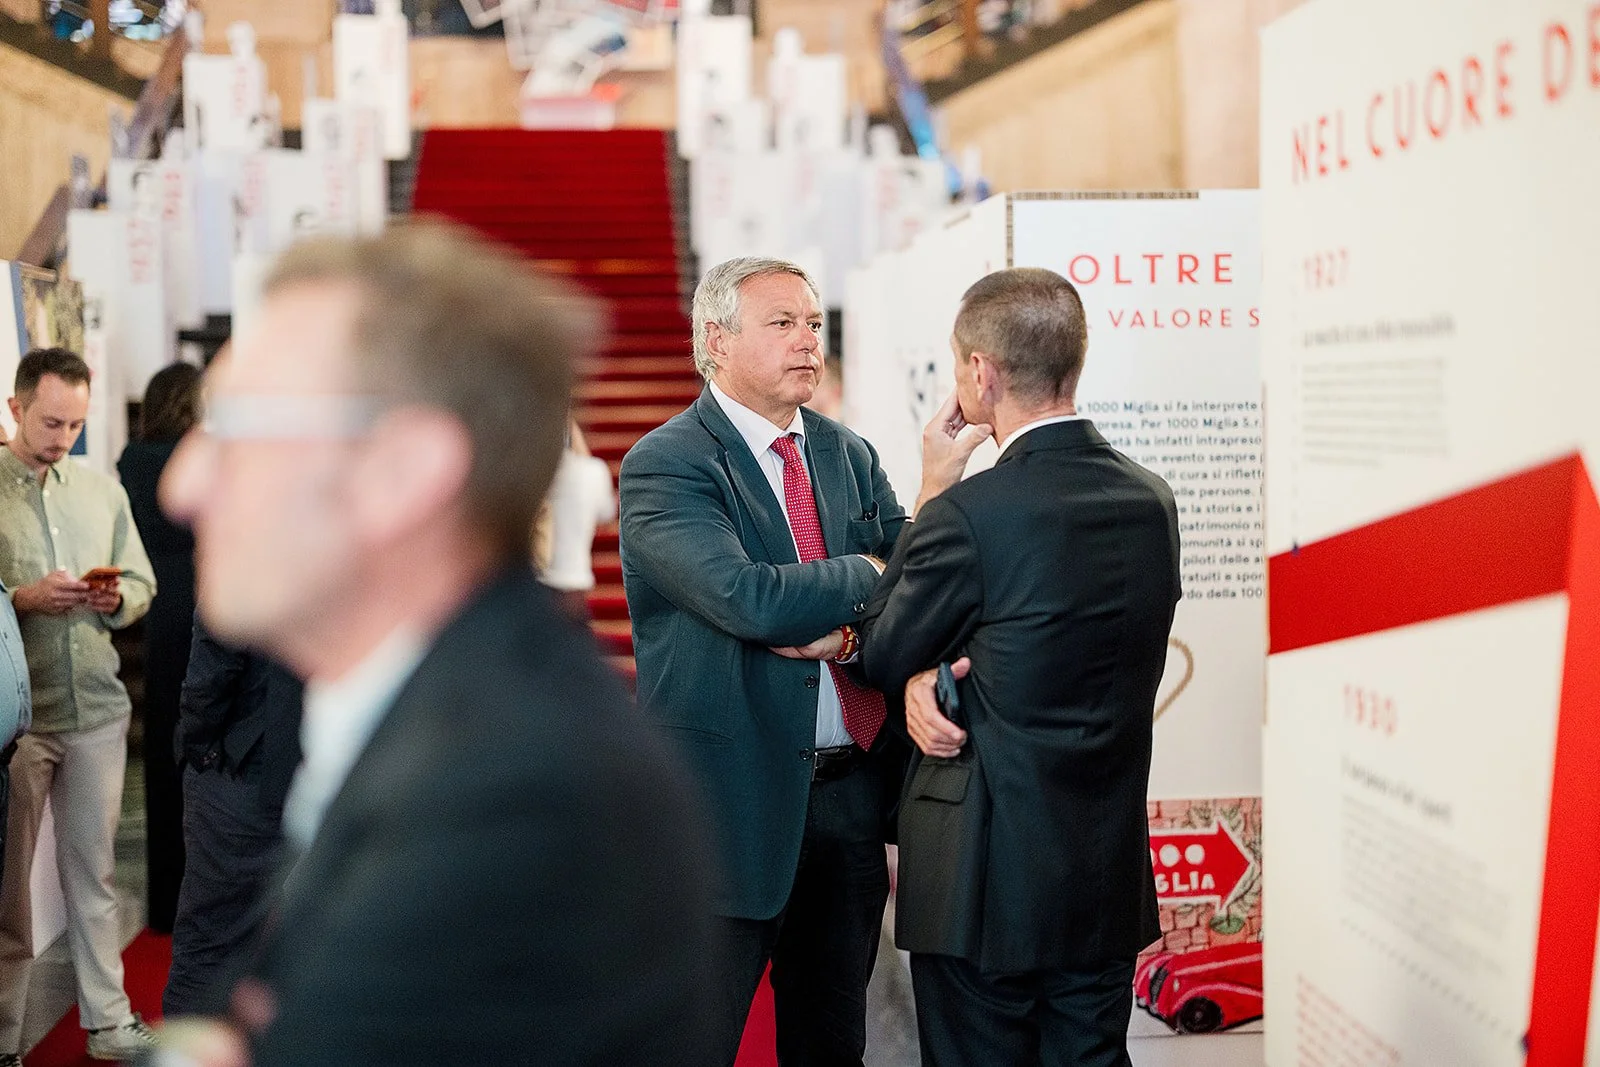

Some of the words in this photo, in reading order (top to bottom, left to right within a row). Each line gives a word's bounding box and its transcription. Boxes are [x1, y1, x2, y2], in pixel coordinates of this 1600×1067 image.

[1292, 109, 1349, 184] NEL
[1366, 39, 1515, 158] CUORE
[1069, 254, 1233, 284] OLTRE
[1108, 309, 1232, 328] VALORE
[1088, 402, 1119, 412] 1000
[1124, 401, 1159, 414] Miglia
[1177, 401, 1188, 411] fa
[1192, 401, 1257, 412] interprete
[1141, 419, 1161, 428] Per
[1168, 418, 1198, 428] 1000
[1203, 418, 1238, 430] Miglia
[1136, 437, 1150, 446] ha
[1155, 436, 1192, 445] infatti
[1197, 436, 1261, 447] intrapreso
[1162, 453, 1205, 462] evento
[1210, 454, 1256, 464] sempre
[1180, 472, 1208, 480] cura
[1207, 503, 1241, 512] storia
[1180, 521, 1249, 532] patrimonio
[1183, 555, 1215, 567] piloti
[1220, 554, 1249, 564] delle
[1225, 573, 1232, 581] e
[1207, 588, 1236, 598] della
